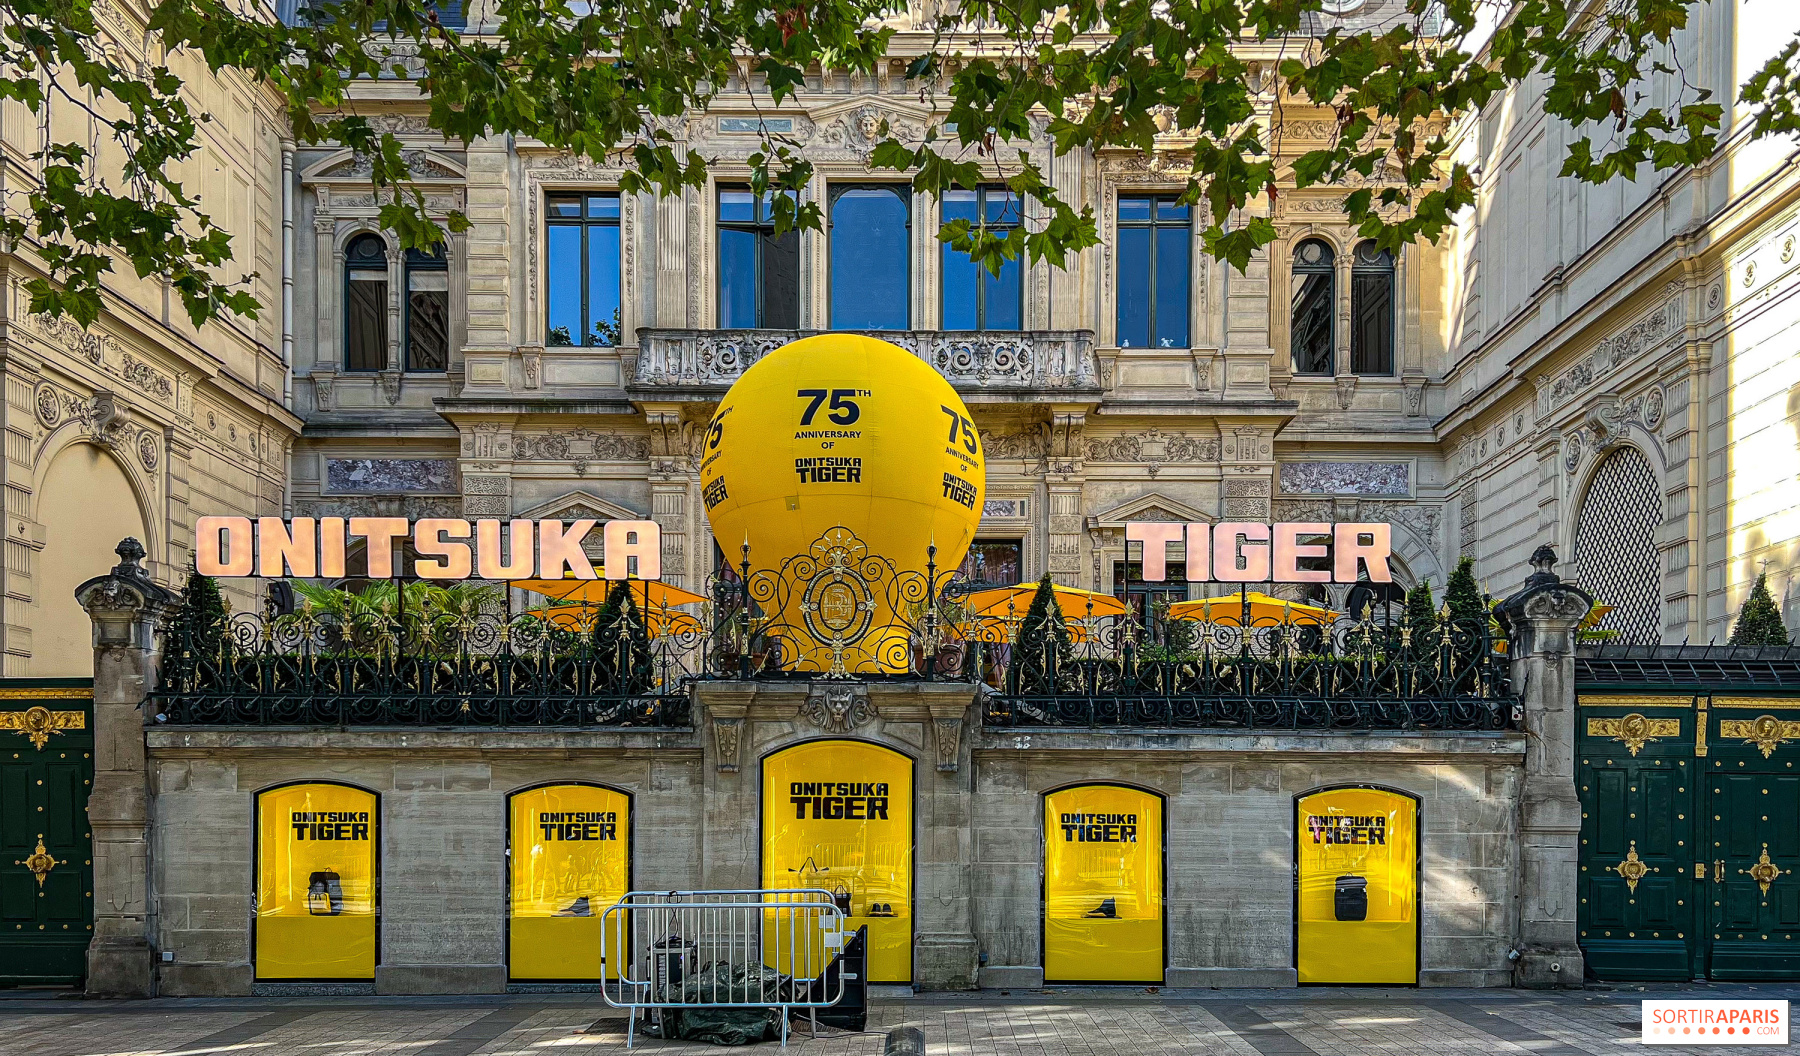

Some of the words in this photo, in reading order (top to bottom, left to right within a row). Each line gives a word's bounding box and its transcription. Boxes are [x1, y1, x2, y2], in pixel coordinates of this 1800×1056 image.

[797, 389, 872, 426] 75TH
[794, 430, 862, 439] ANNIVERSARY
[821, 441, 835, 449] OF
[795, 457, 862, 467] ONITSUKA
[945, 446, 979, 470] ANNIVERSARY
[706, 467, 712, 476] OF
[795, 467, 862, 484] TIGER
[960, 464, 968, 473] OF
[943, 472, 977, 496] ONITSUKA
[704, 484, 729, 512] TIGER
[942, 481, 976, 511] TIGER
[195, 515, 662, 580] ONITSUKA
[1125, 522, 1393, 583] TIGER
[789, 782, 889, 796] ONITSUKA
[291, 811, 369, 823] ONITSUKA
[539, 811, 617, 823] ONITSUKA
[789, 796, 889, 820] TIGER
[1060, 812, 1138, 825] ONITSUKA
[1308, 815, 1386, 826] ONITSUKA
[291, 823, 369, 841] TIGER
[539, 823, 617, 841] TIGER
[1060, 825, 1138, 843] TIGER
[1308, 826, 1386, 845] TIGER
